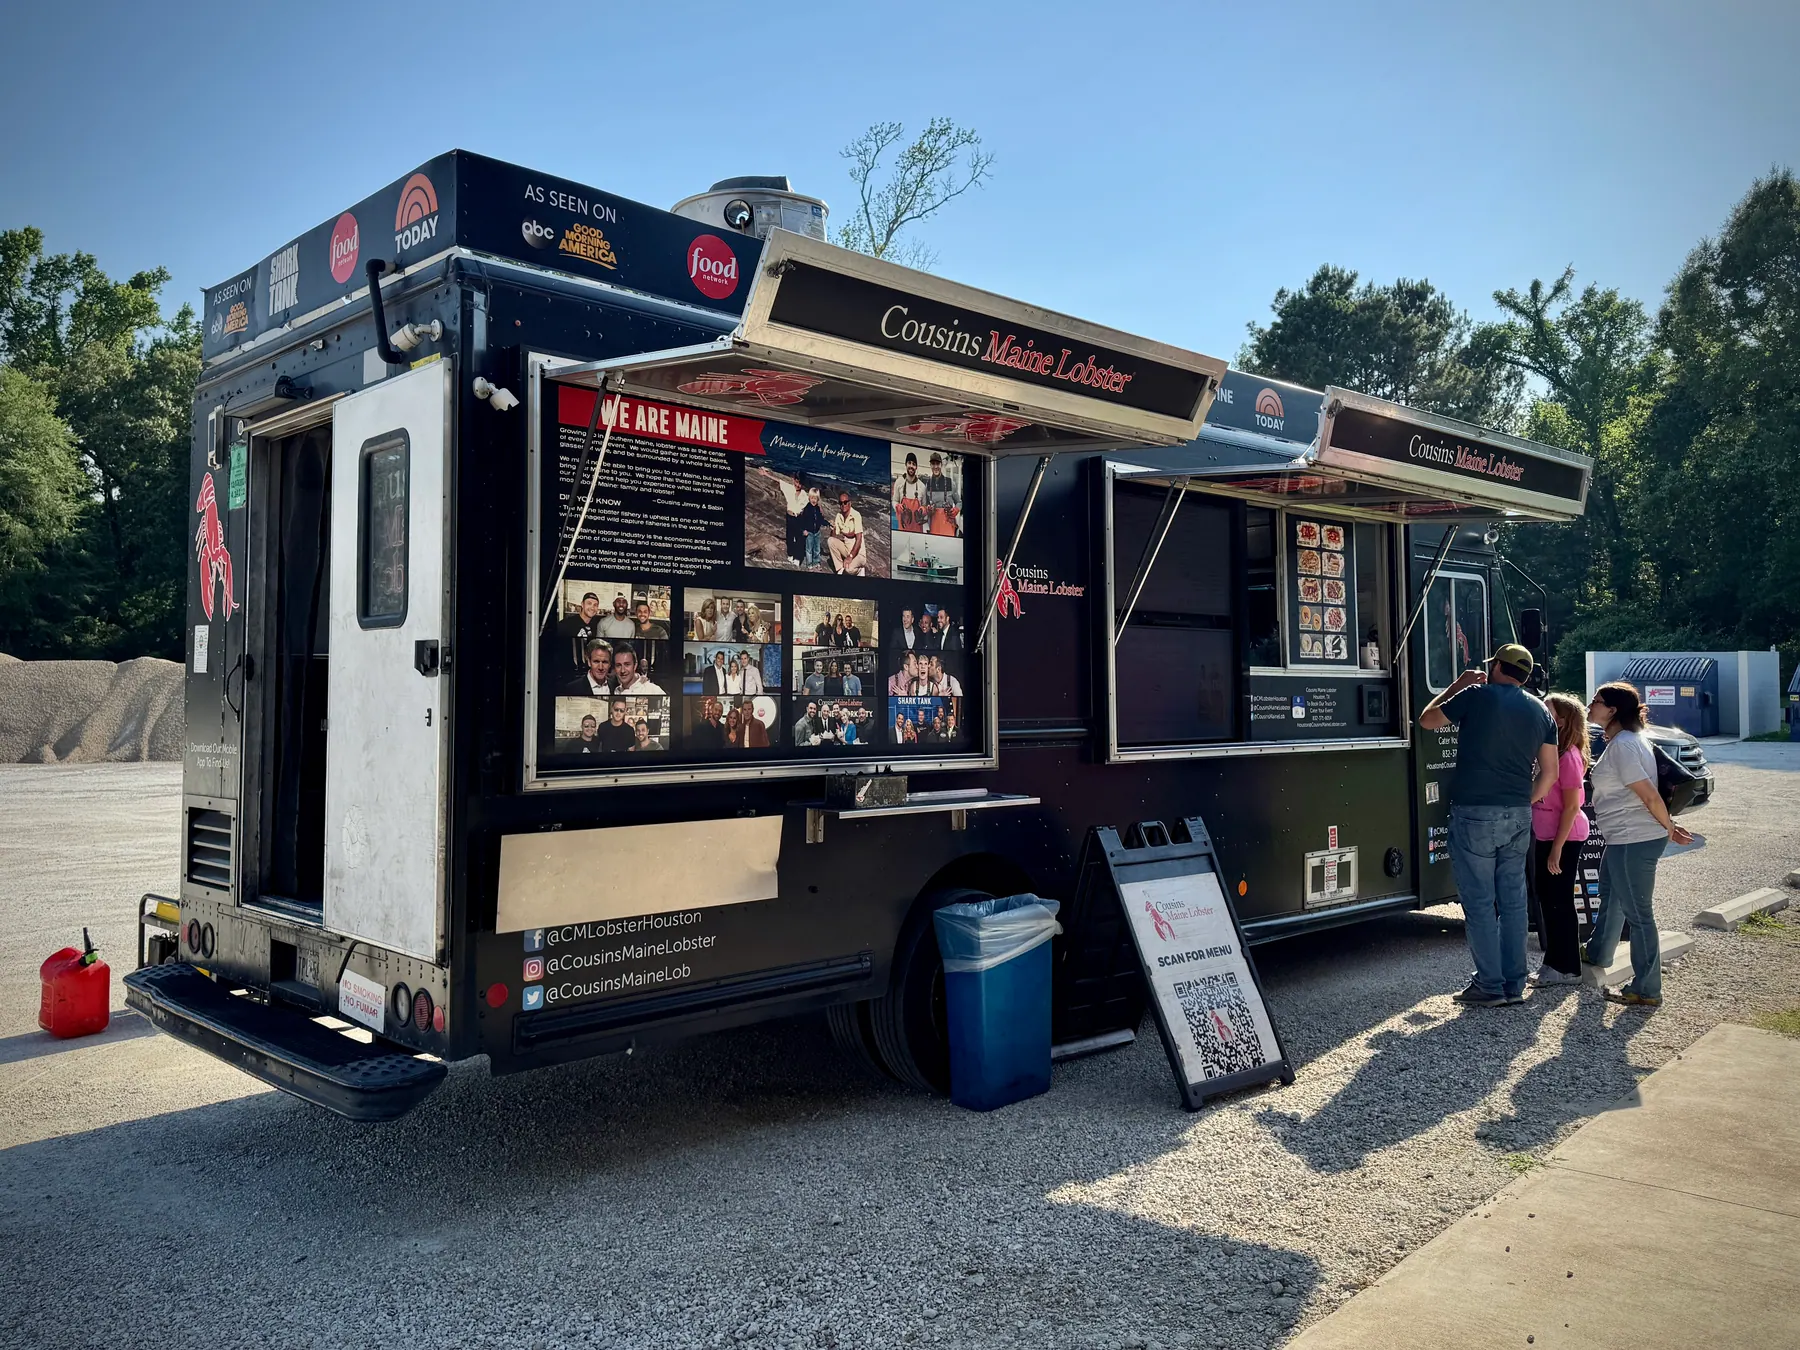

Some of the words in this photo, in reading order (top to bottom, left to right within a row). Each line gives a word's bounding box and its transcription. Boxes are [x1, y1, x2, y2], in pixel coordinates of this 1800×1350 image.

[525, 184, 545, 204] AS
[549, 189, 588, 216] SEEN
[593, 204, 616, 224] ON
[394, 215, 439, 254] TODAY
[521, 219, 554, 242] abc
[564, 231, 610, 251] MORNING
[572, 222, 603, 239] GOOD
[270, 243, 299, 279] SHARK
[331, 231, 357, 272] food
[338, 254, 353, 267] network
[559, 239, 617, 265] AMERICA
[690, 246, 736, 280] food
[213, 287, 222, 306] AS
[222, 282, 238, 302] SEEN
[240, 276, 251, 293] ON
[703, 274, 728, 286] network
[269, 273, 298, 316] TANK
[881, 305, 983, 357] Cousins
[981, 331, 1054, 375] Maine
[1055, 349, 1132, 393] Lobster
[560, 427, 586, 436] Growing
[601, 399, 629, 428] WE
[635, 405, 669, 436] ARE
[676, 412, 727, 444] MAINE
[1255, 414, 1284, 431] TODAY
[636, 453, 670, 462] surrounded
[770, 435, 797, 447] Maine
[801, 442, 818, 458] just
[822, 445, 836, 458] few
[1409, 434, 1454, 464] Cousins
[1455, 445, 1487, 473] Maine
[1487, 454, 1524, 481] Lobster
[643, 481, 676, 489] experience
[596, 498, 621, 506] KNOW
[1008, 564, 1048, 579] Cousins
[1017, 579, 1048, 594] Maine
[1049, 581, 1084, 596] Lobster
[191, 742, 212, 753] Download
[213, 743, 222, 753] Our
[197, 757, 205, 769] App
[206, 757, 211, 767] To
[1155, 899, 1185, 913] Cousins
[1166, 909, 1188, 922] Maine
[1188, 906, 1214, 919] Lobster
[547, 911, 702, 946] @CMLobsterHouston
[546, 934, 716, 975] @CousinsMaineLobster
[1157, 953, 1186, 967] SCAN
[1187, 949, 1205, 962] FOR
[1207, 944, 1233, 958] MENU
[343, 980, 351, 990] NO
[353, 984, 382, 1004] SMOKING
[546, 964, 691, 1003] @CousinsMaineLob
[346, 995, 354, 1006] NO
[357, 1001, 378, 1018] FUMAR
